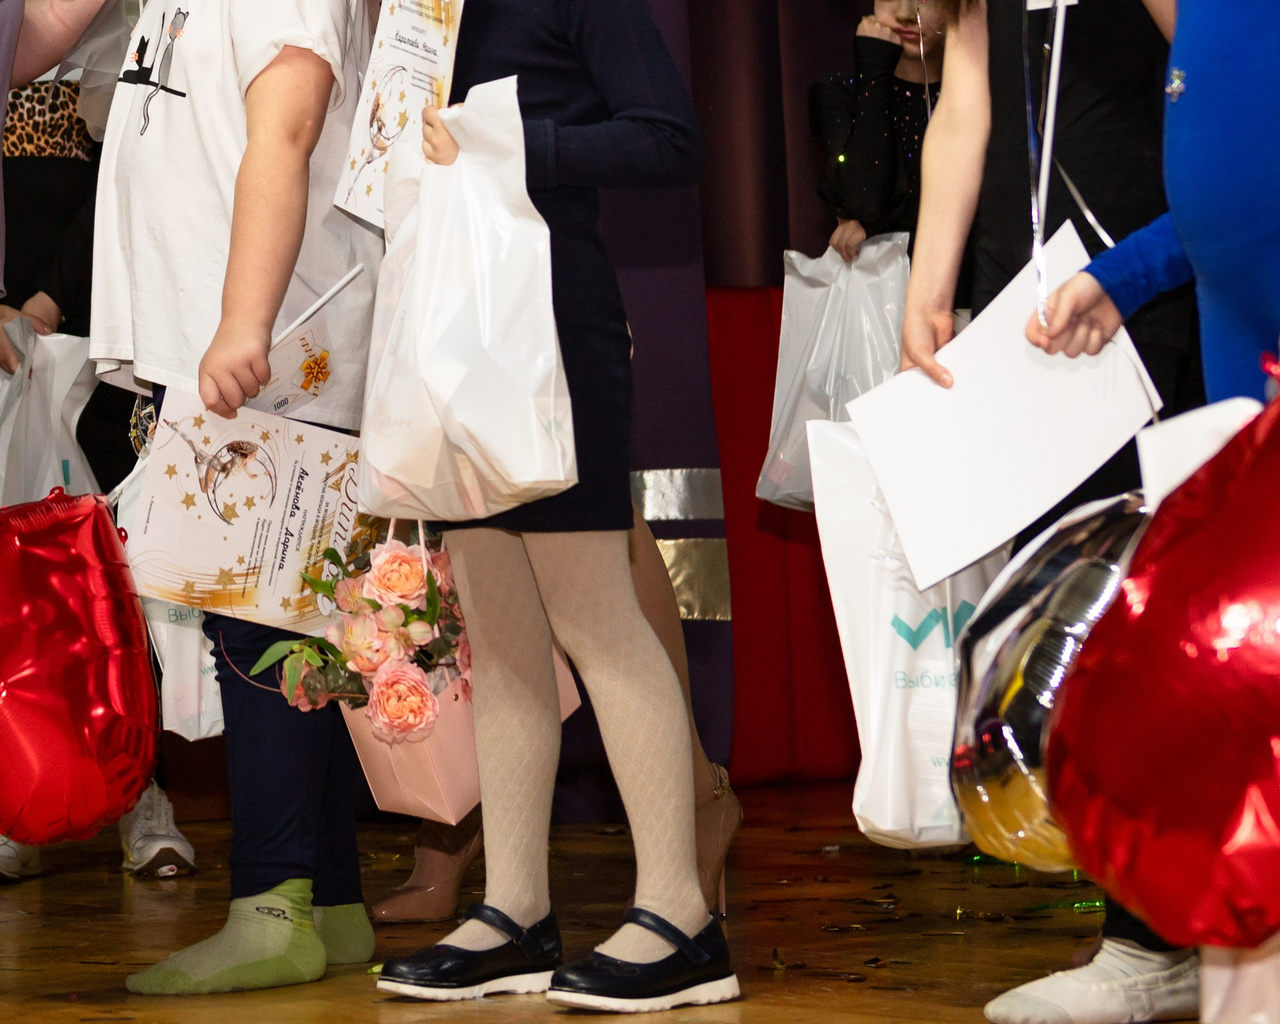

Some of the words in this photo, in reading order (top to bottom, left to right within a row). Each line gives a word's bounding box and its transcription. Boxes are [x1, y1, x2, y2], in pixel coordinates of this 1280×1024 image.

[273, 397, 289, 411] 1000
[278, 527, 294, 571] Дарина
[168, 607, 202, 623] Выб
